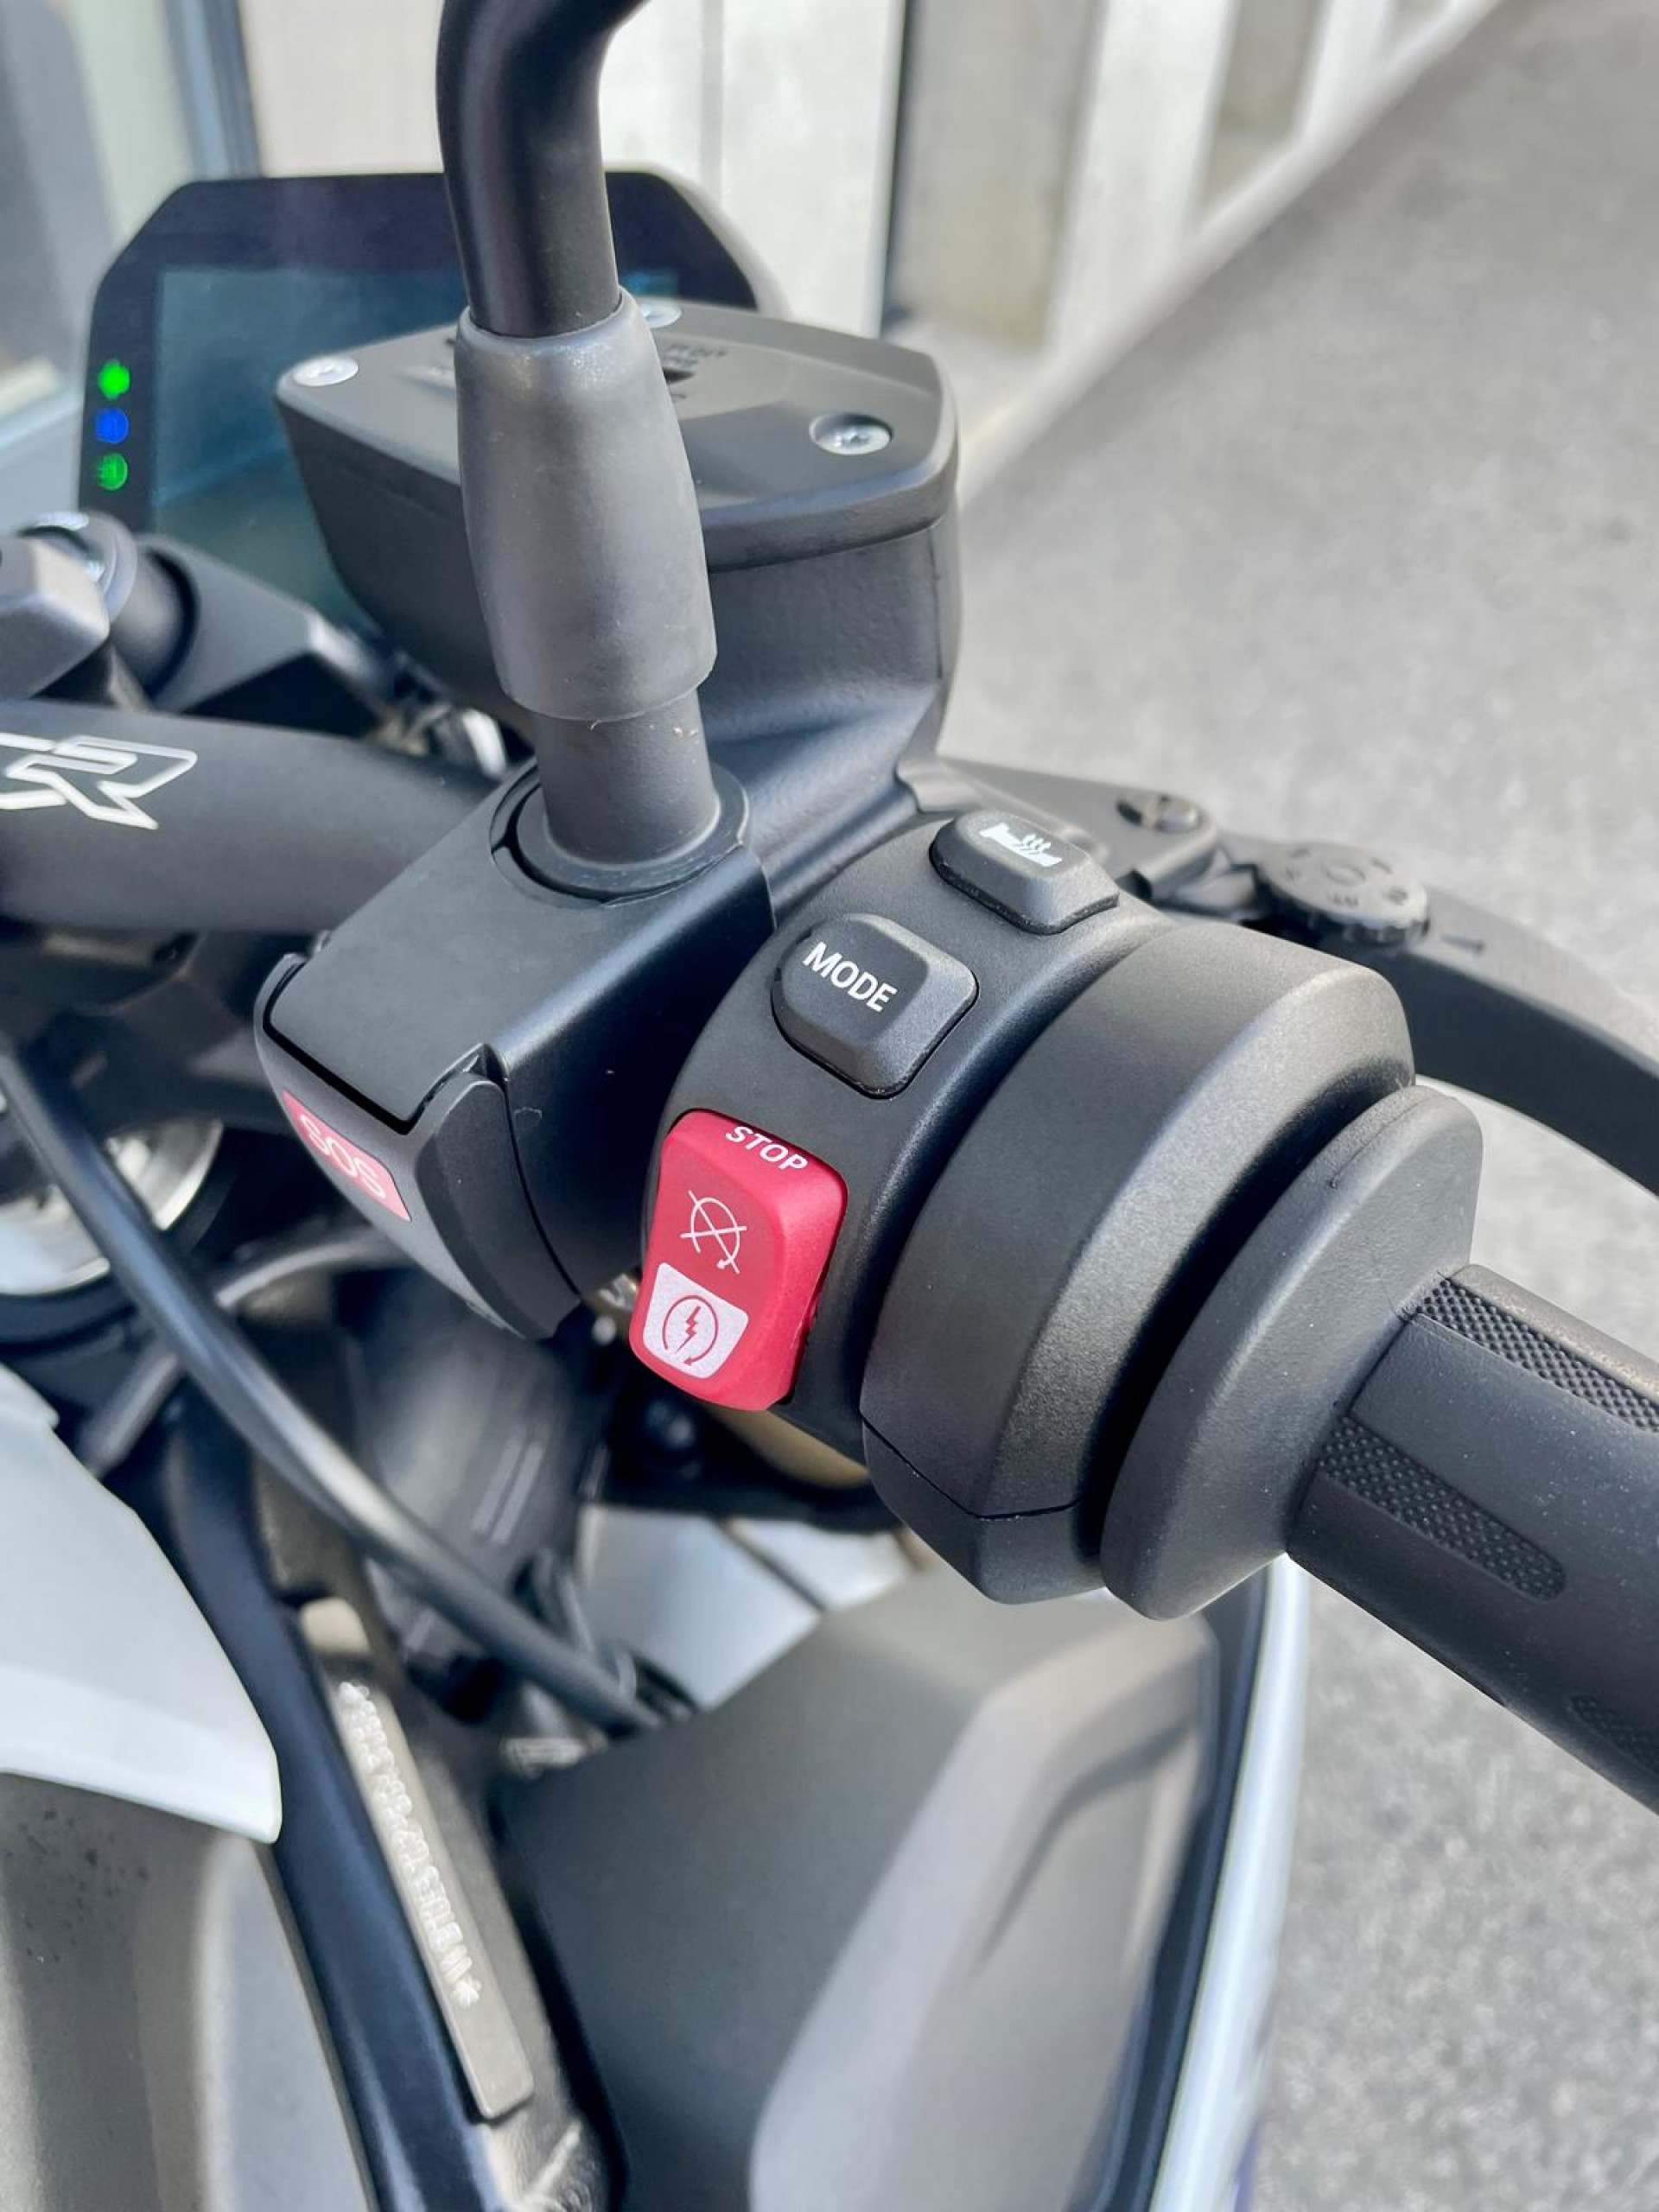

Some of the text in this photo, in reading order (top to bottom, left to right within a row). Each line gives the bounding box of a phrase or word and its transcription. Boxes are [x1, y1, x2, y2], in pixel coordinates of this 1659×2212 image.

[802, 941, 899, 1013] MODE
[299, 1114, 386, 1199] SOS
[725, 1126, 808, 1170] STOP
